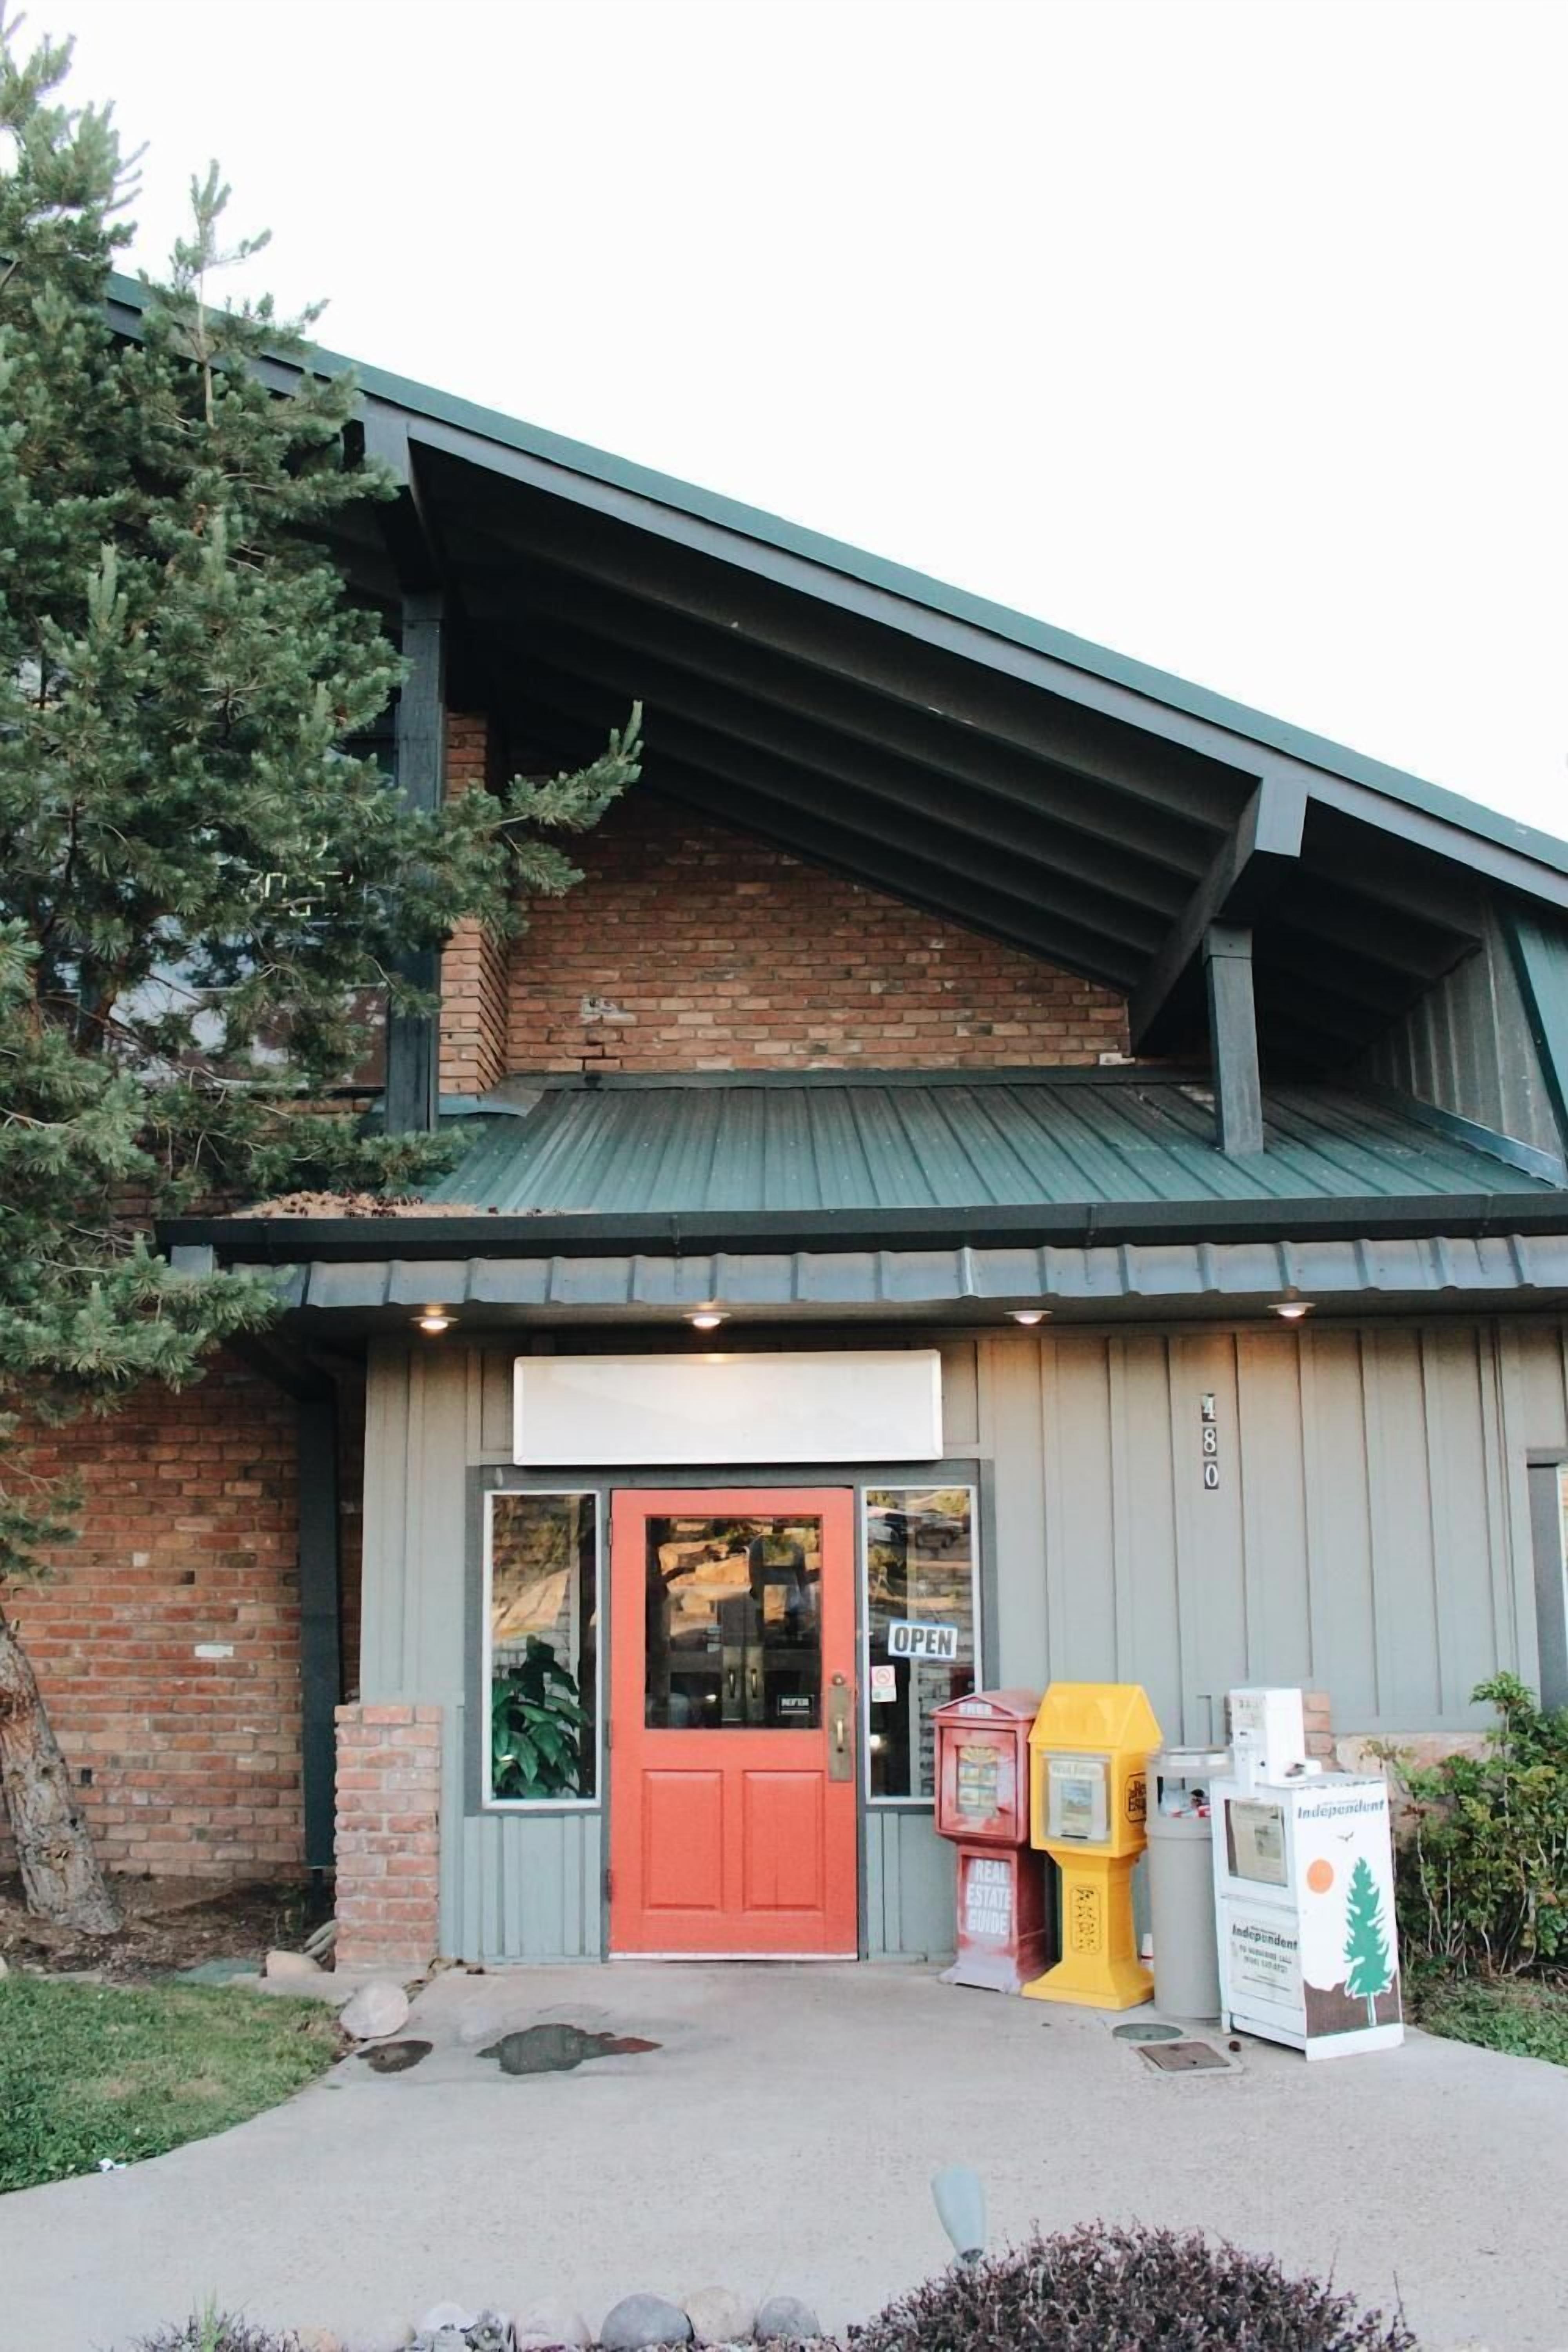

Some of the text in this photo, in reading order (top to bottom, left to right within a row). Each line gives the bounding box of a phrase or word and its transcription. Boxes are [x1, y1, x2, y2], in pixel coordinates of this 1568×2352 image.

[894, 1627, 952, 1655] OPEN
[1298, 1798, 1384, 1819] Independent
[975, 1860, 1008, 1883] REAL
[967, 1883, 1012, 1909] ESTATE
[968, 1909, 1009, 1935] GUIDE
[1232, 1923, 1298, 1951] Independent
